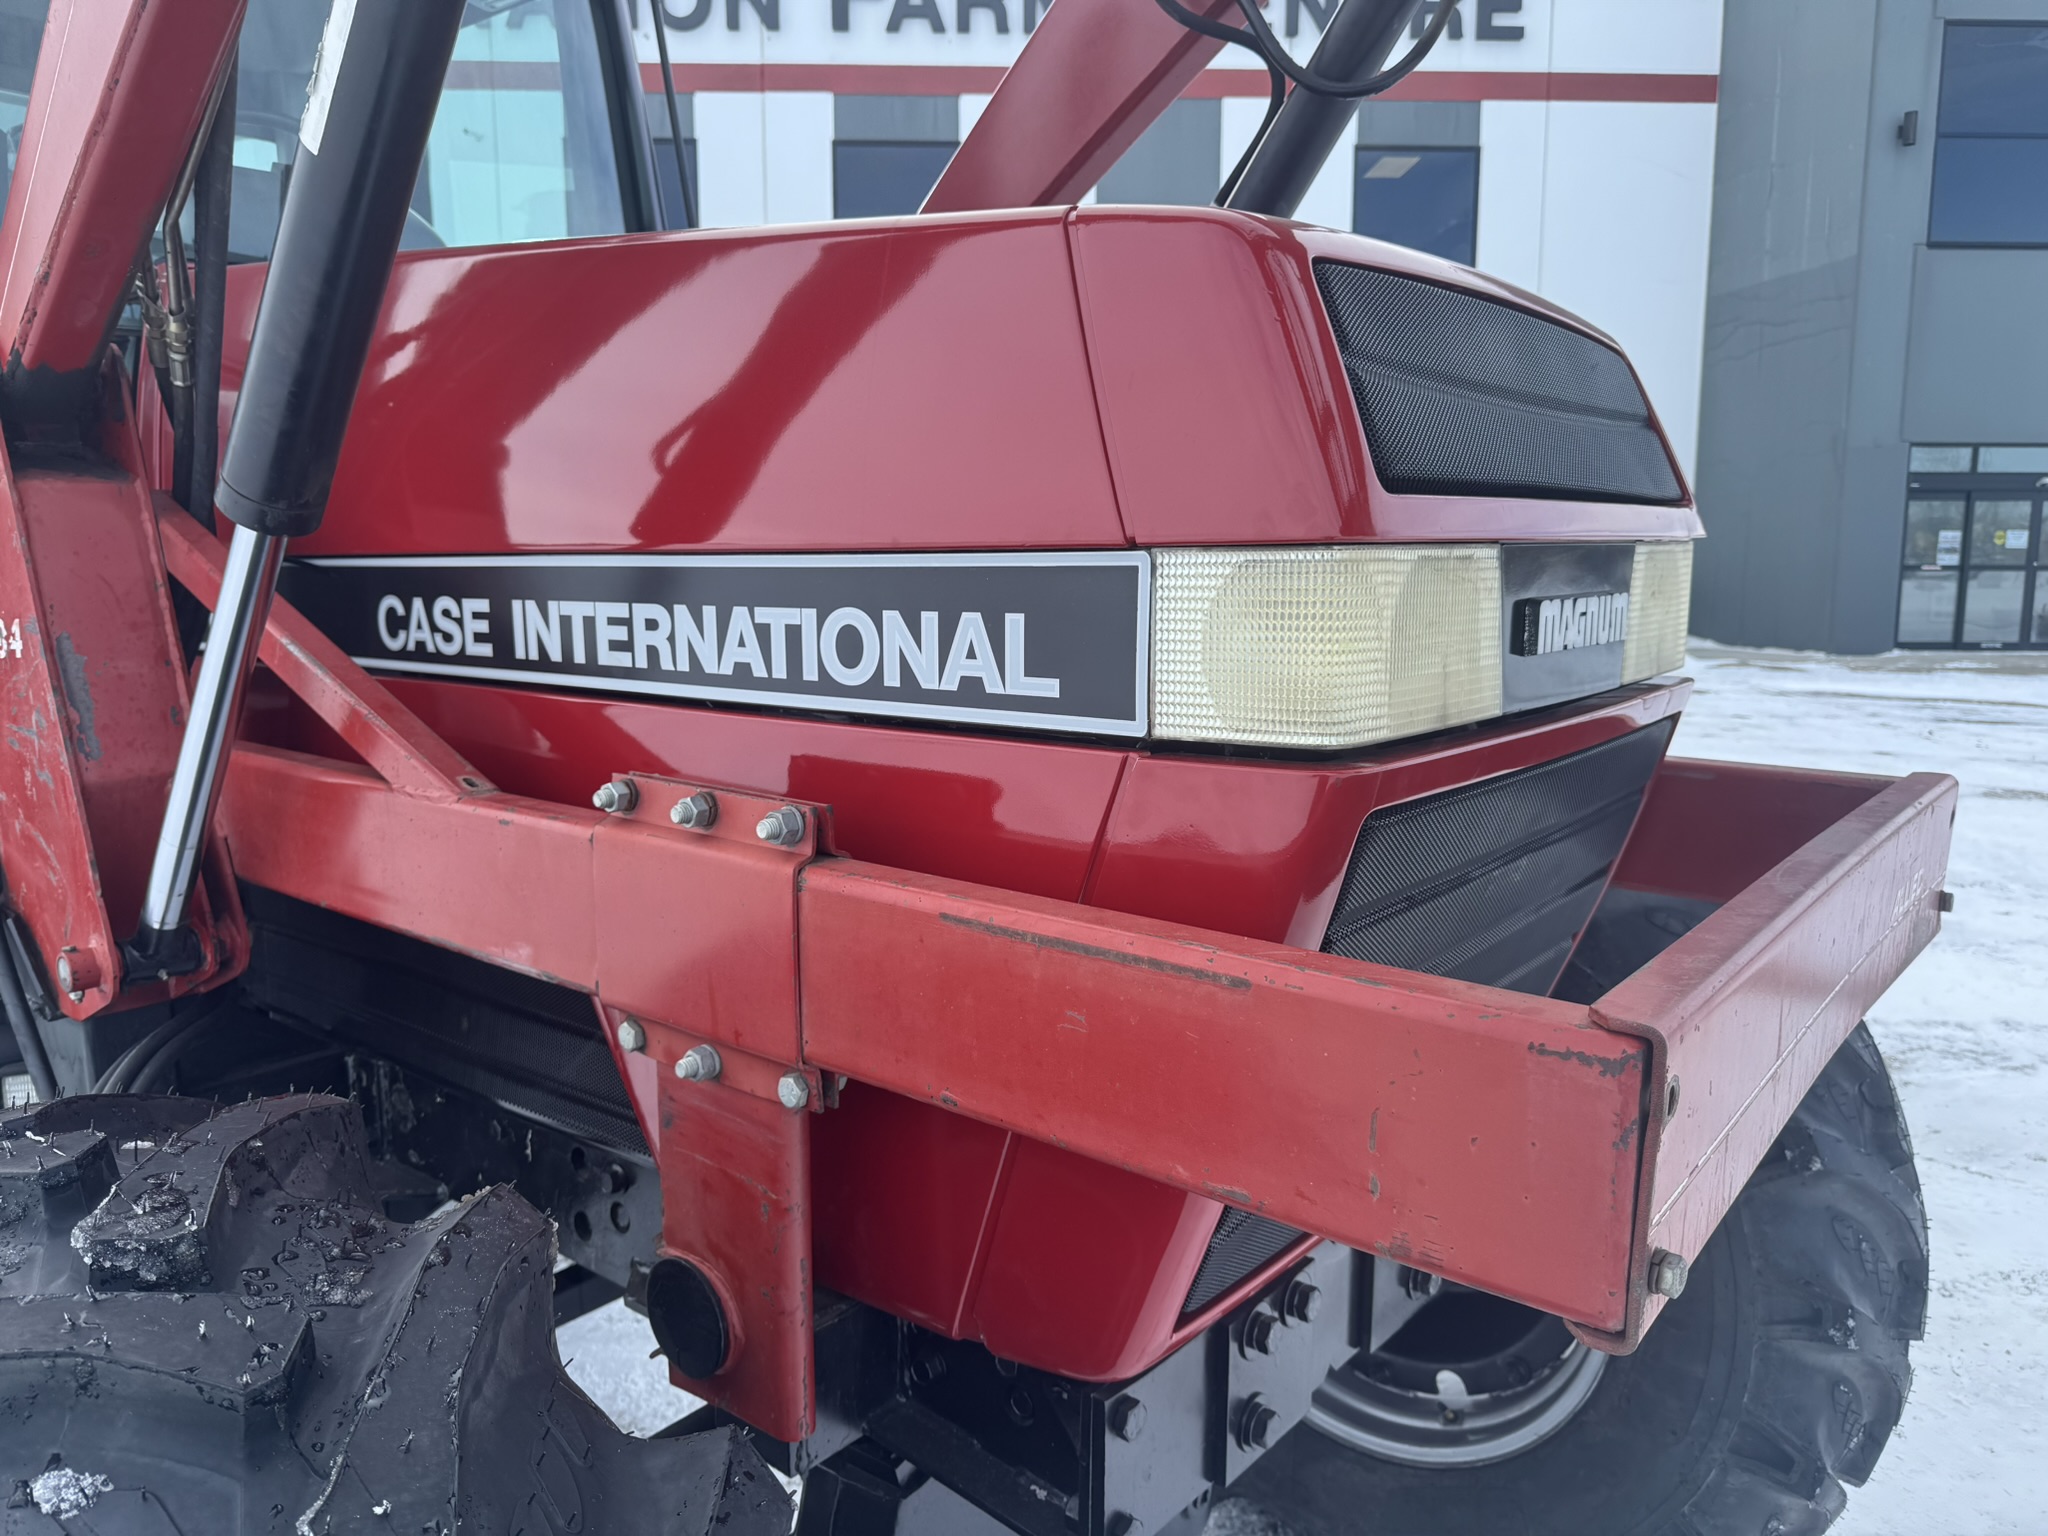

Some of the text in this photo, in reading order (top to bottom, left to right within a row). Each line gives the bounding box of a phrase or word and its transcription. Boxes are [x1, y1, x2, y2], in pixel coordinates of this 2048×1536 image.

[377, 594, 1060, 698] CASE INTERNATIONAL
[1537, 592, 1629, 655] MAGNUM
